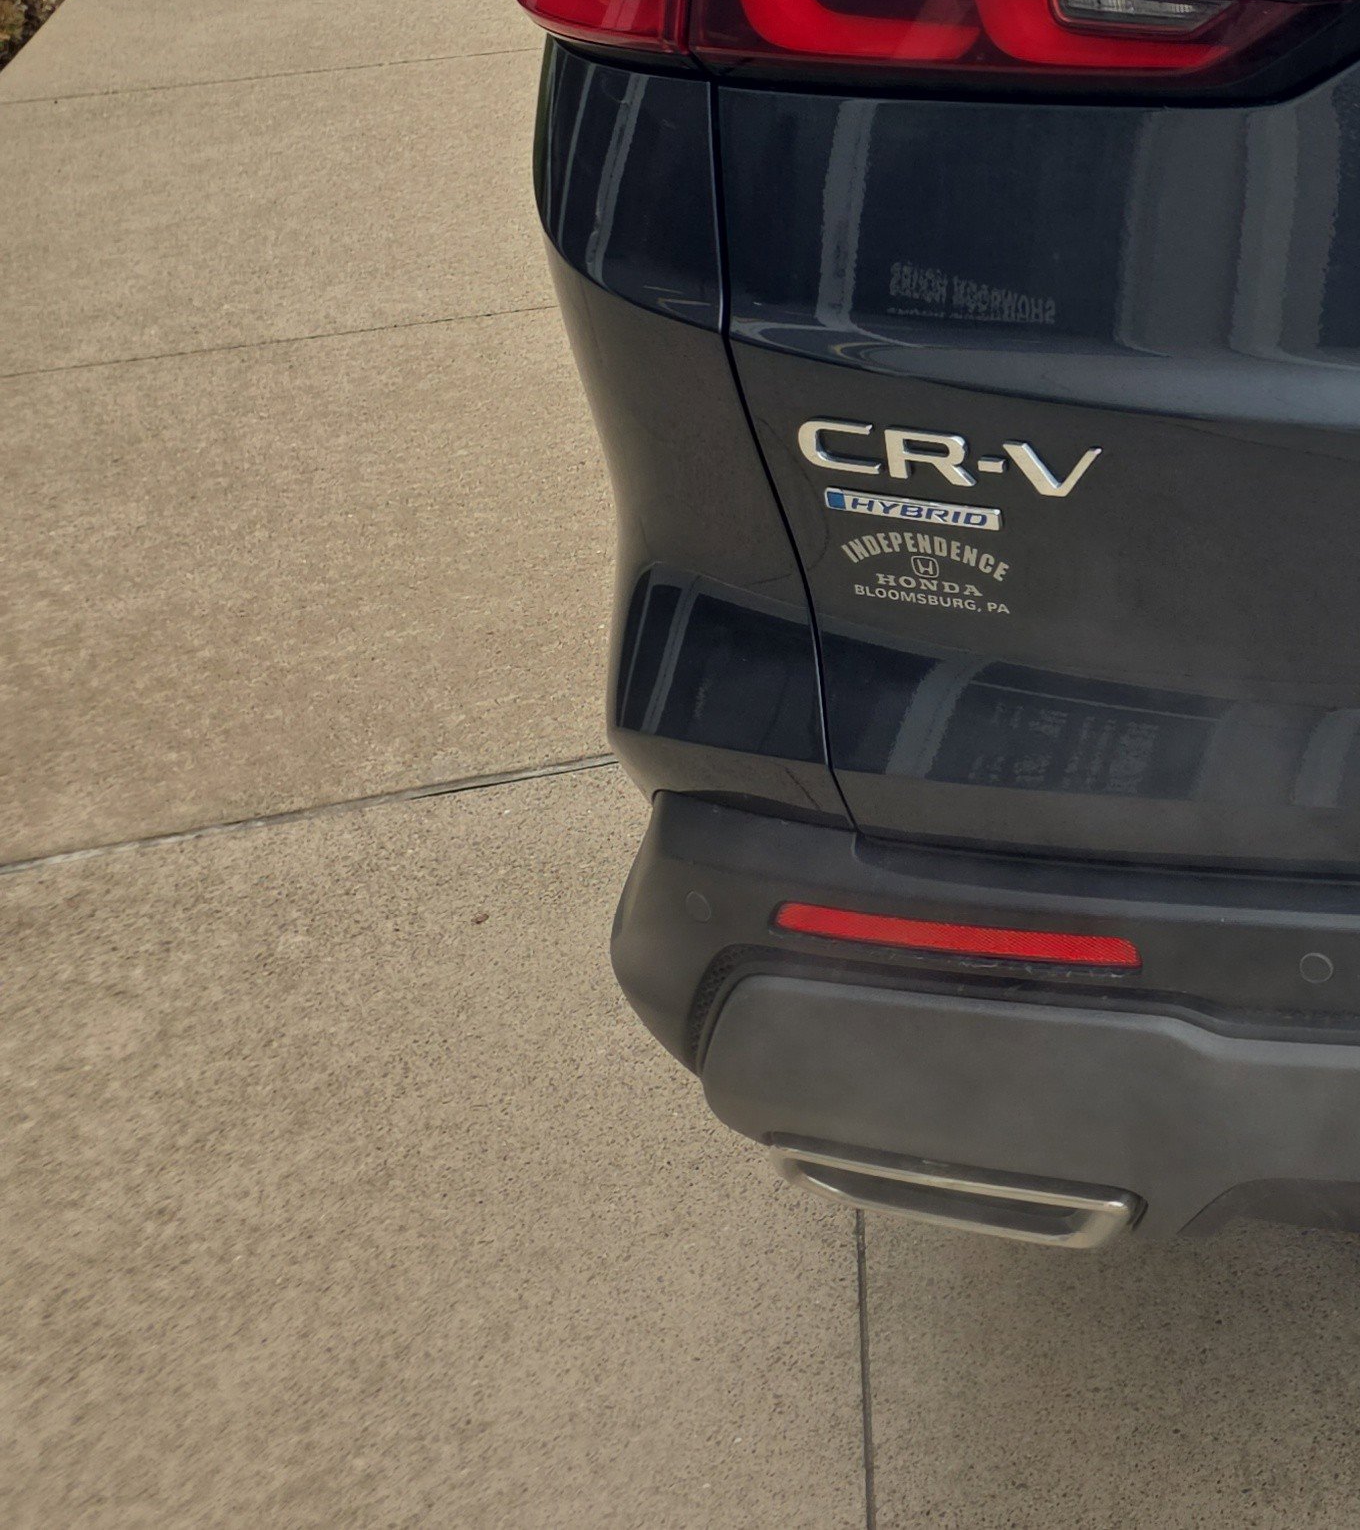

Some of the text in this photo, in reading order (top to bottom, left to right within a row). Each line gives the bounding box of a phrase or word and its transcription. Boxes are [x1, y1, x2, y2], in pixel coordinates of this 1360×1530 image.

[798, 419, 1103, 497] CR-V
[850, 497, 988, 527] HYBRID
[841, 531, 1010, 582] INDEPENDENCE
[854, 584, 1011, 614] BLOOMSBURG, PA
[875, 573, 984, 597] HONDA
